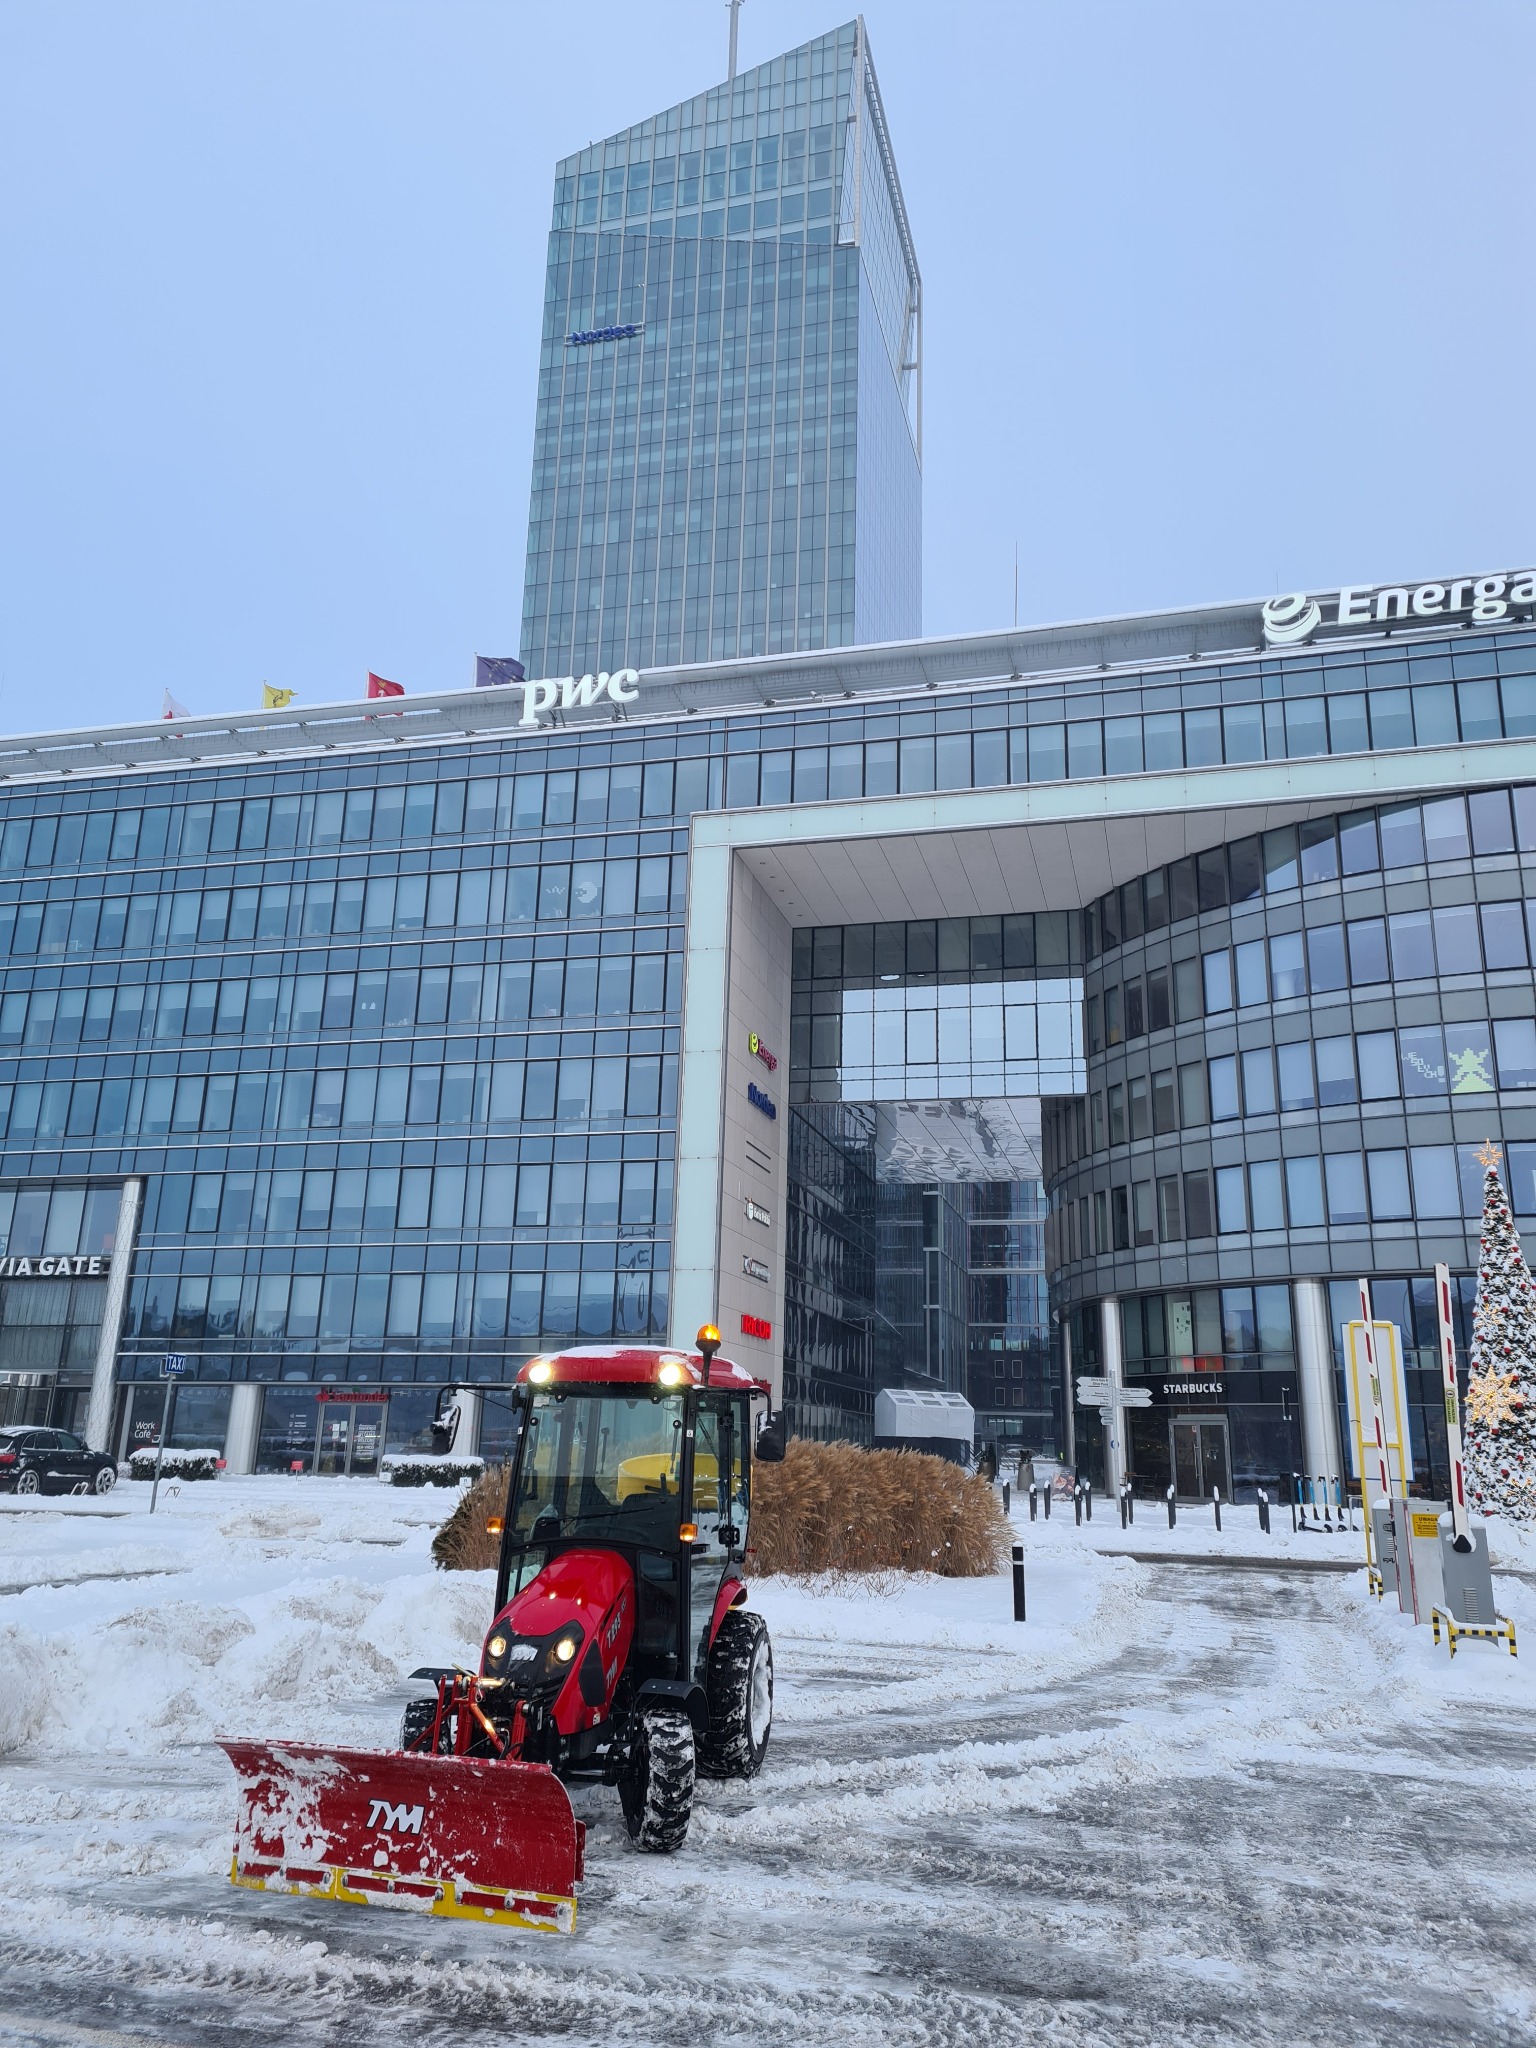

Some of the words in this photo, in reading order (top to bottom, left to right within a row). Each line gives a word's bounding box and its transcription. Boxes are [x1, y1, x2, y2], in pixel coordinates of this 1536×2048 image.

[572, 324, 636, 345] Nordea
[1338, 571, 1536, 626] Energa
[518, 668, 640, 727] pwc
[757, 1038, 778, 1073] Energa
[39, 1256, 102, 1276] GATE
[742, 1314, 772, 1340] RICOH
[168, 1355, 185, 1371] TAXI
[331, 1392, 389, 1403] Santander
[1163, 1383, 1223, 1394] STARBUCKS
[134, 1430, 151, 1439] Café
[136, 1421, 155, 1430] Work
[366, 1798, 426, 1836] TYM
